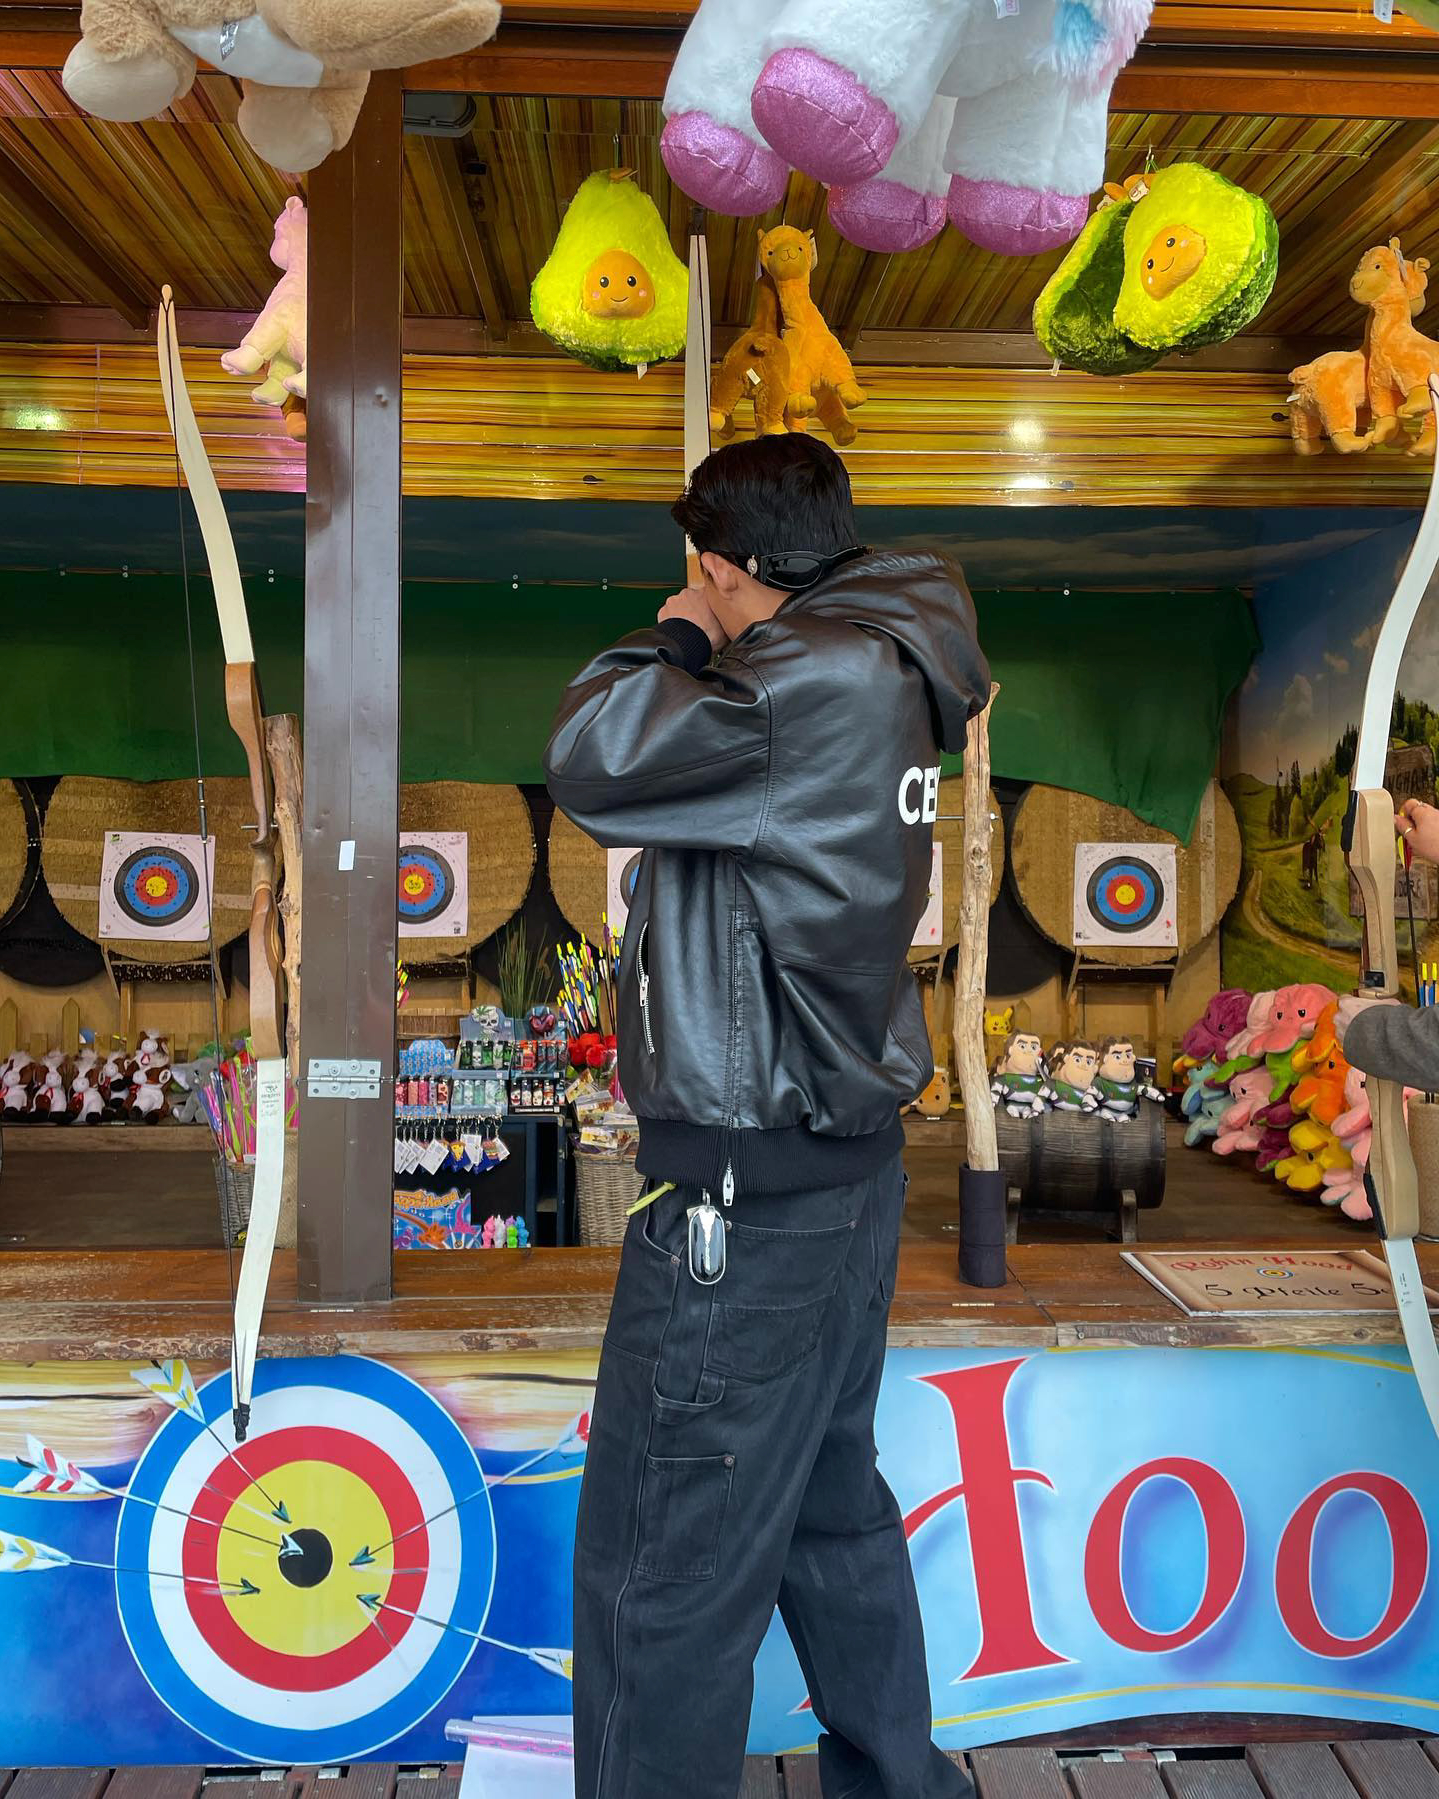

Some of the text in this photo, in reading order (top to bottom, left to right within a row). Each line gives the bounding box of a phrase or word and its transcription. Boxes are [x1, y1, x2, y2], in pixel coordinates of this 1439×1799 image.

[898, 766, 941, 825] CE
[1170, 1256, 1352, 1271] Robin Hood
[1205, 1284, 1232, 1297] 5
